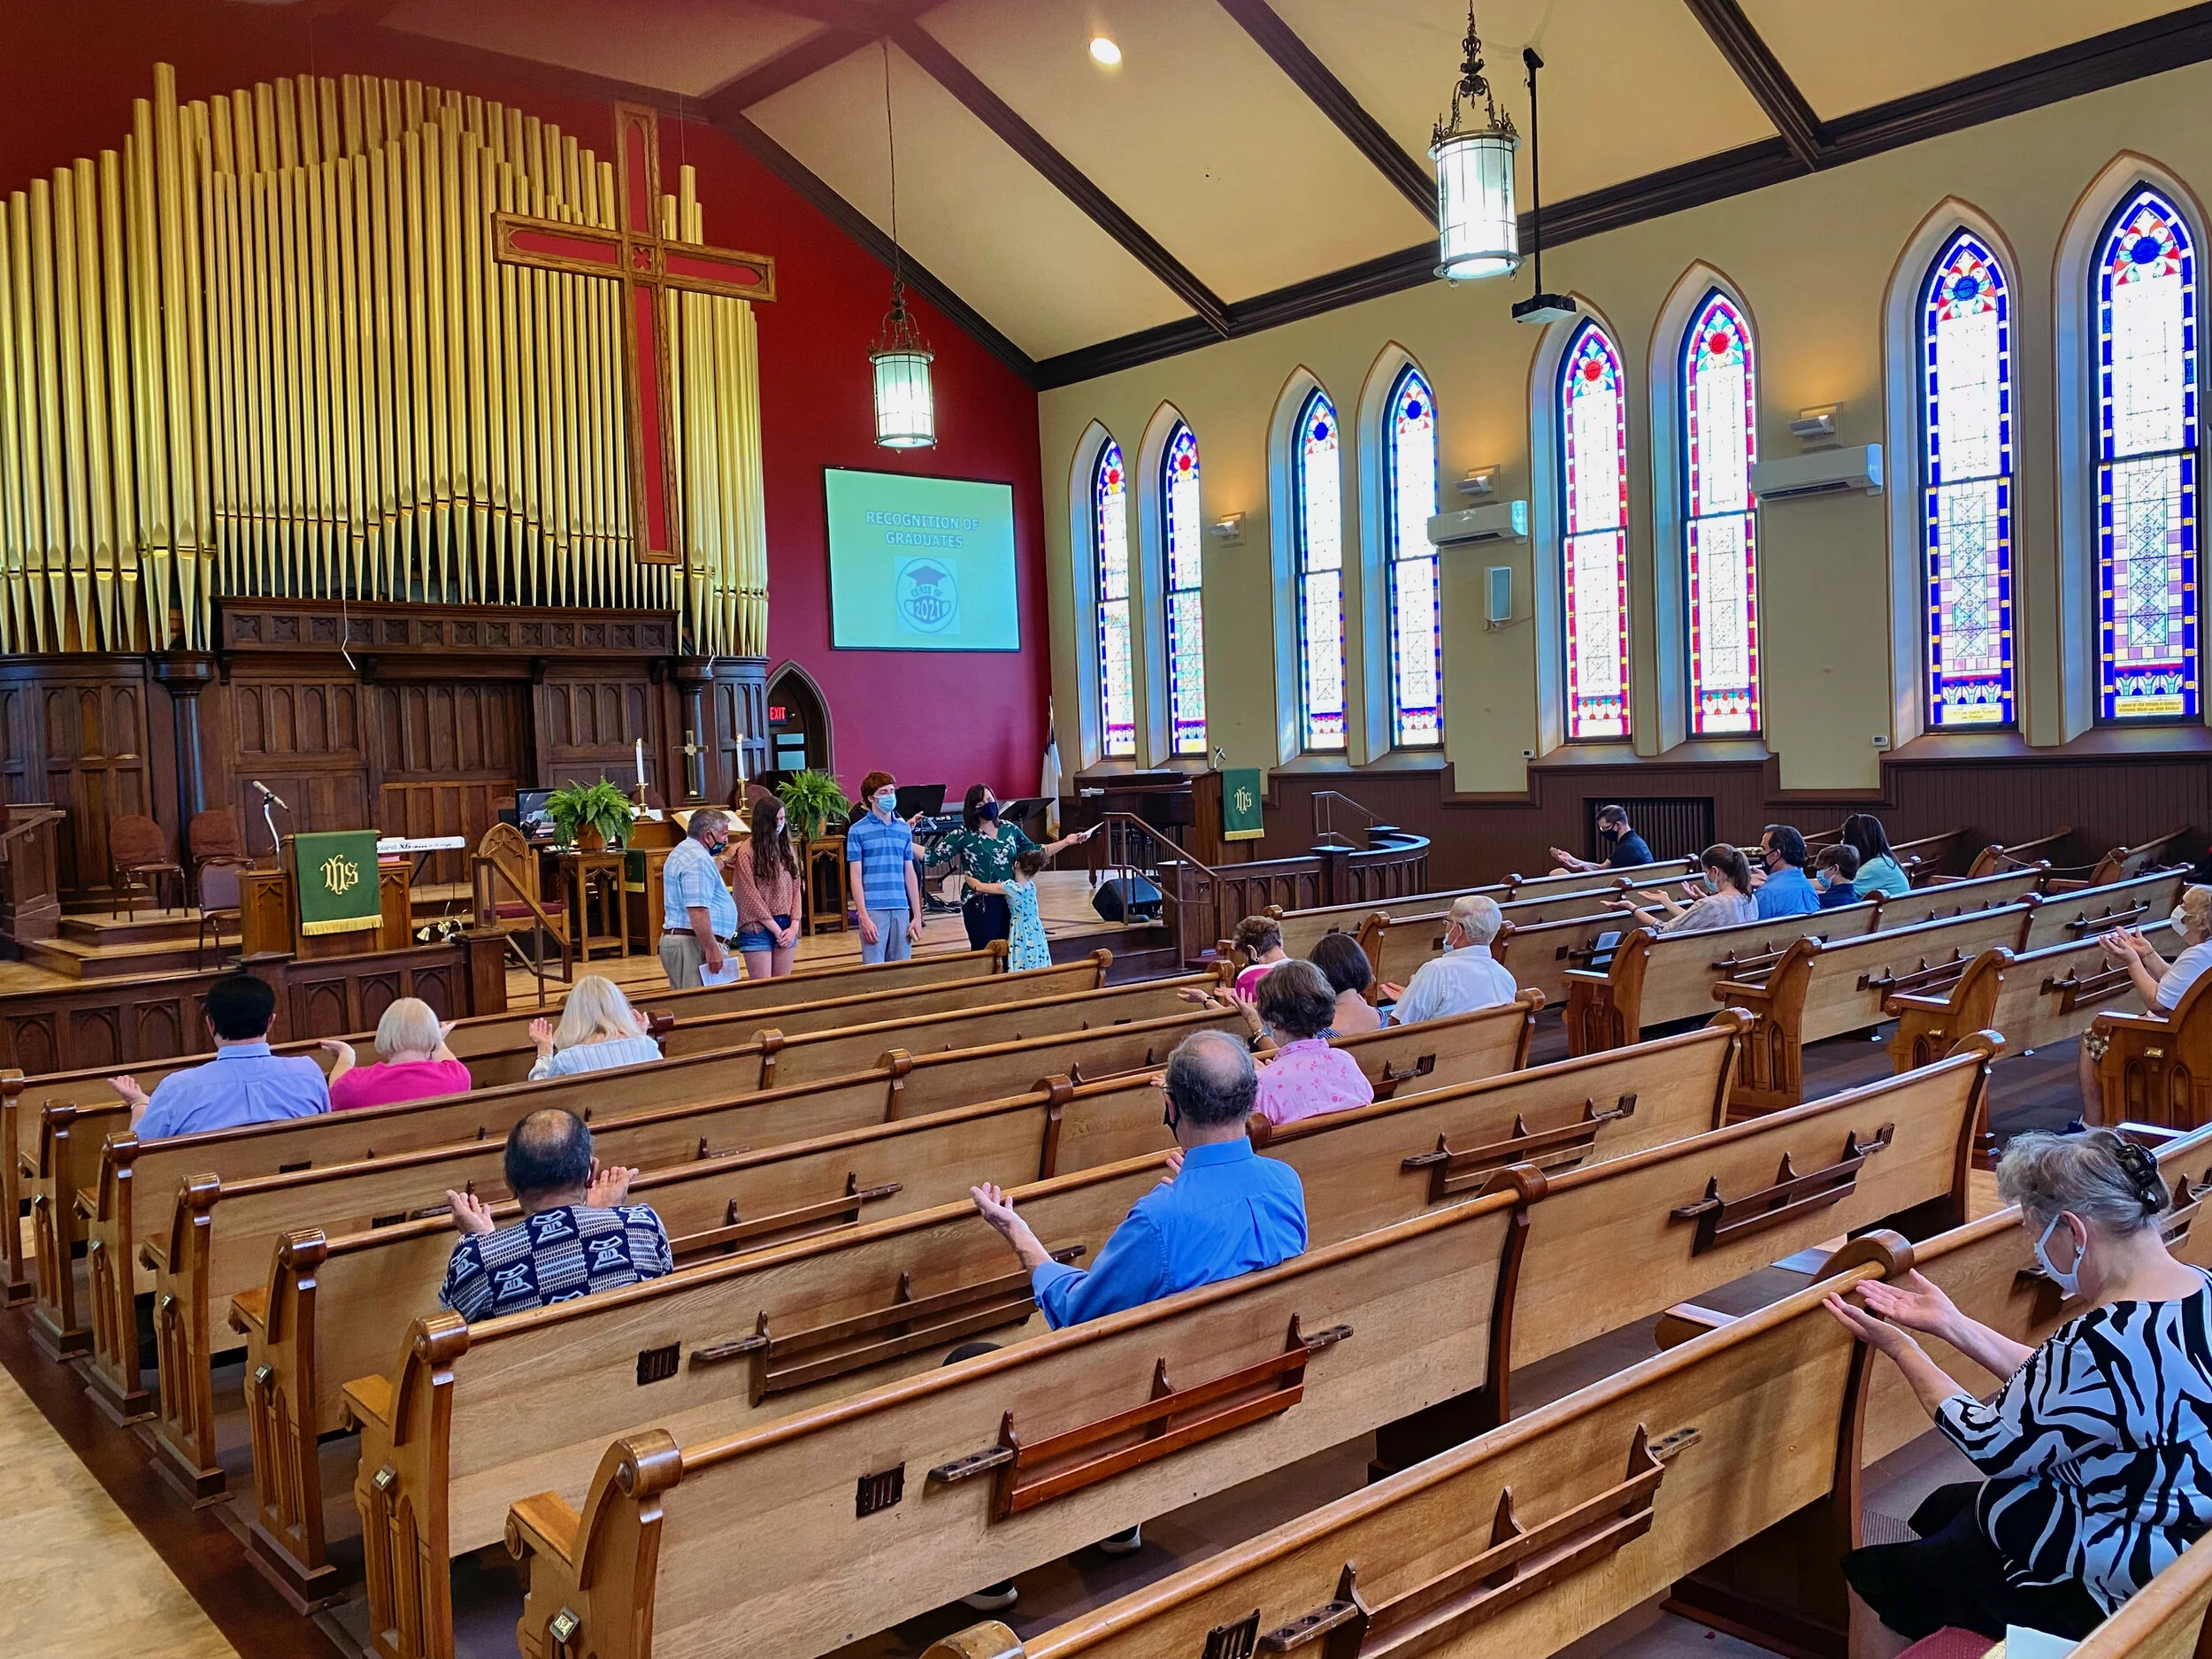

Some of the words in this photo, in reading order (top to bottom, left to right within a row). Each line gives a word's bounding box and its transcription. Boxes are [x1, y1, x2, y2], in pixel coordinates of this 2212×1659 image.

[866, 511, 960, 530] RECOGNITION
[962, 518, 979, 532] OF
[886, 531, 964, 549] GRADUATES
[910, 585, 932, 598] CLASS
[915, 599, 941, 620] 2021
[769, 706, 787, 720] EXIT
